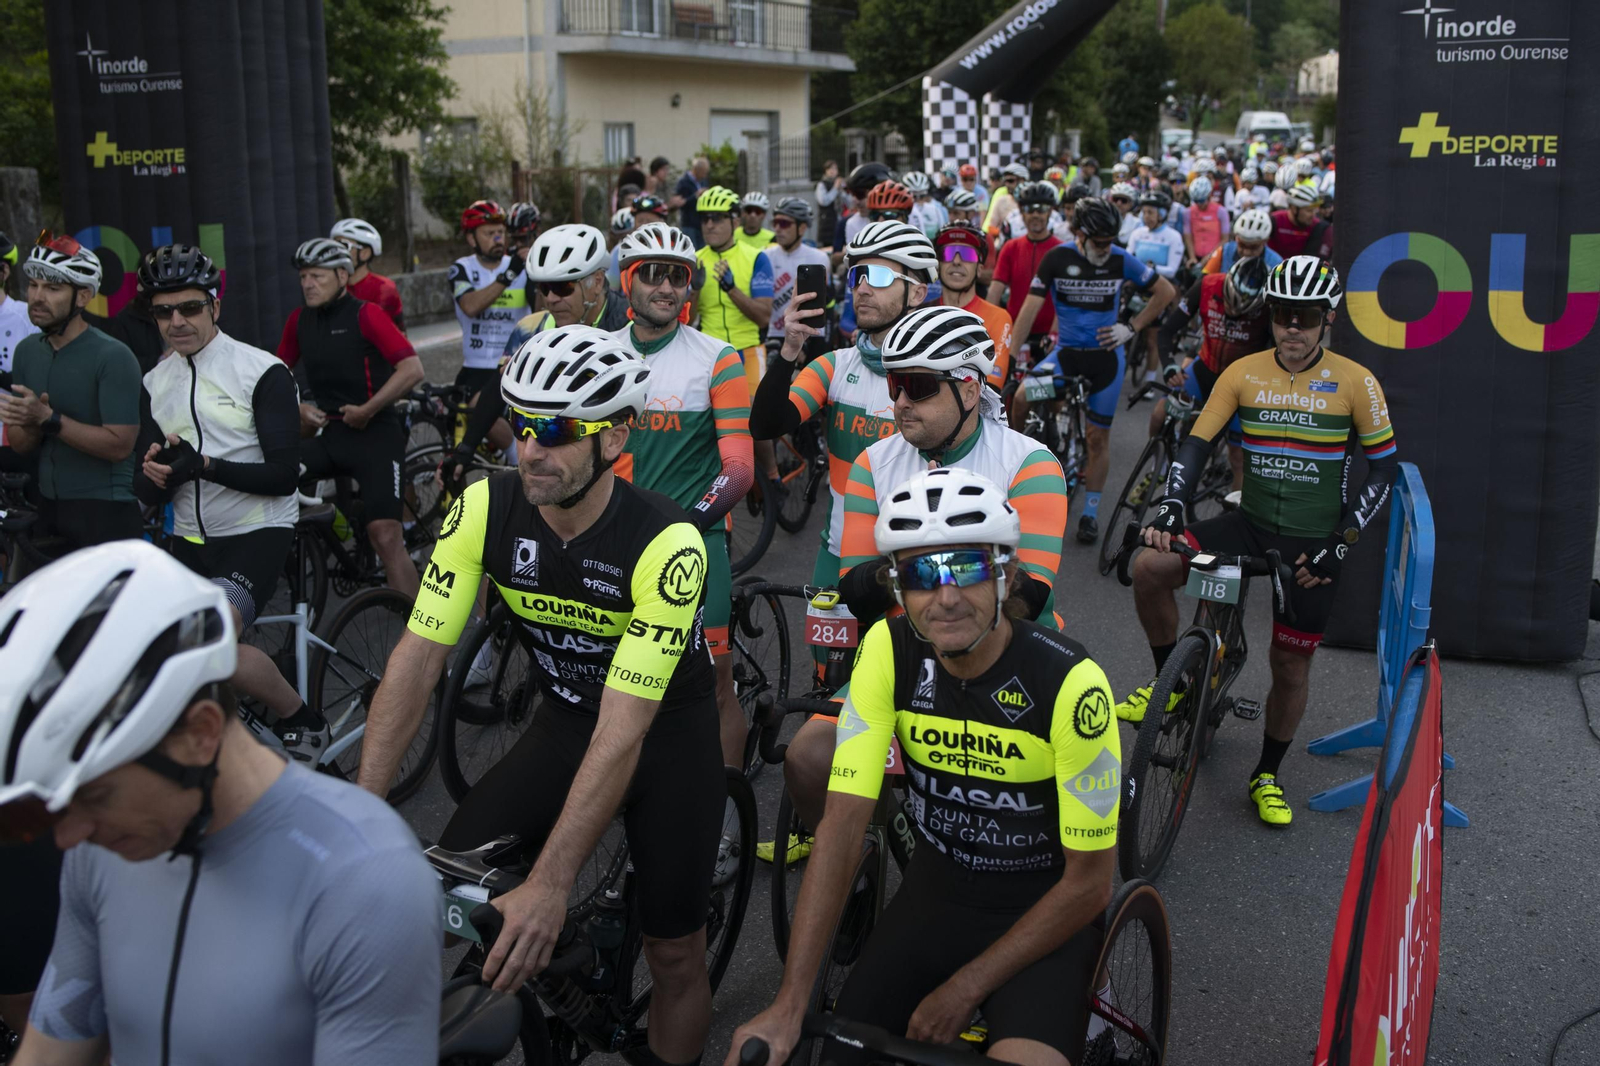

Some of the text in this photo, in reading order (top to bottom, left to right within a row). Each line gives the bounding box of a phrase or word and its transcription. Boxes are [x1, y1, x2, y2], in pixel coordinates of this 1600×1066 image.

[1436, 15, 1517, 38] inorde
[1436, 45, 1569, 63] turismo Ourense
[97, 56, 148, 74] inorde
[100, 79, 183, 94] turismo Ourense
[133, 165, 149, 176] La
[1474, 154, 1497, 168] La
[773, 272, 792, 293] LUB
[1345, 232, 1600, 353] OU
[1254, 390, 1328, 412] Alentejo
[1364, 376, 1381, 426] Ourique
[850, 414, 902, 440] ROD
[1259, 410, 1318, 426] GRAVEL
[1284, 472, 1320, 484] Cycling
[511, 576, 539, 587] CRAEGA
[1201, 580, 1226, 599] 118
[521, 595, 616, 627] LOURIÑA
[536, 613, 605, 634] CYCLING TEAM
[812, 624, 849, 644] 284
[544, 630, 620, 653] LASA
[1032, 631, 1075, 657] OTTOBOSLEY
[558, 659, 608, 676] XUNTA
[560, 669, 580, 681] DE
[997, 689, 1027, 707] OdL
[910, 725, 1026, 760] LOURIÑA
[930, 776, 1044, 811] LASAL
[931, 804, 1000, 831] XUNTA
[928, 817, 1049, 847] DE GALICIA
